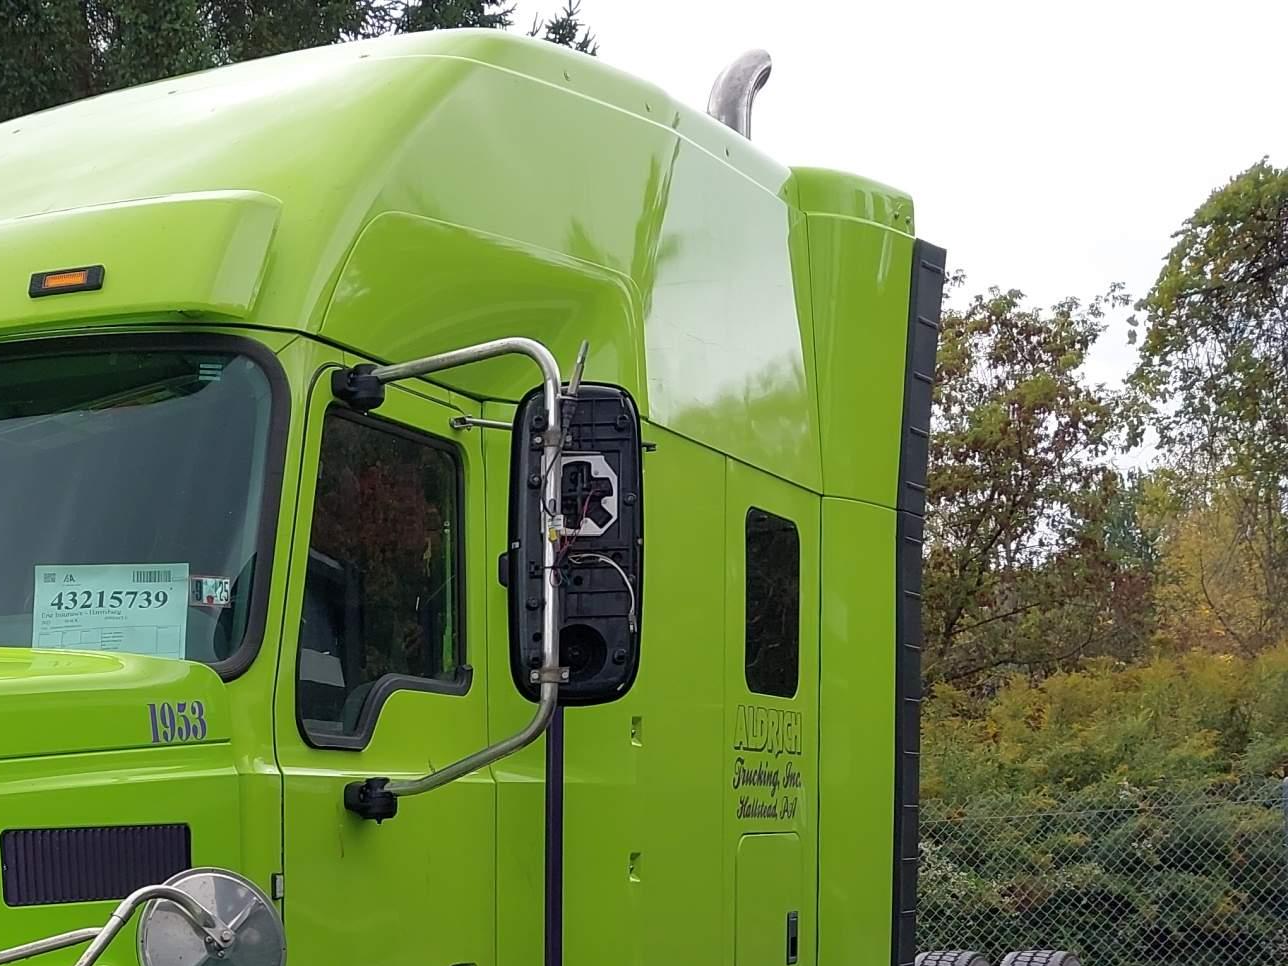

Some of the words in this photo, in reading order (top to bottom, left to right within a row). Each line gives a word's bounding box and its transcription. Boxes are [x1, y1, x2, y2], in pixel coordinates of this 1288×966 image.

[50, 589, 169, 611] 43215739
[218, 581, 229, 602] 25
[147, 700, 208, 744] 1953
[734, 705, 802, 757] ALDRICH
[733, 757, 779, 797] Trucking,
[783, 761, 802, 788] Inc.
